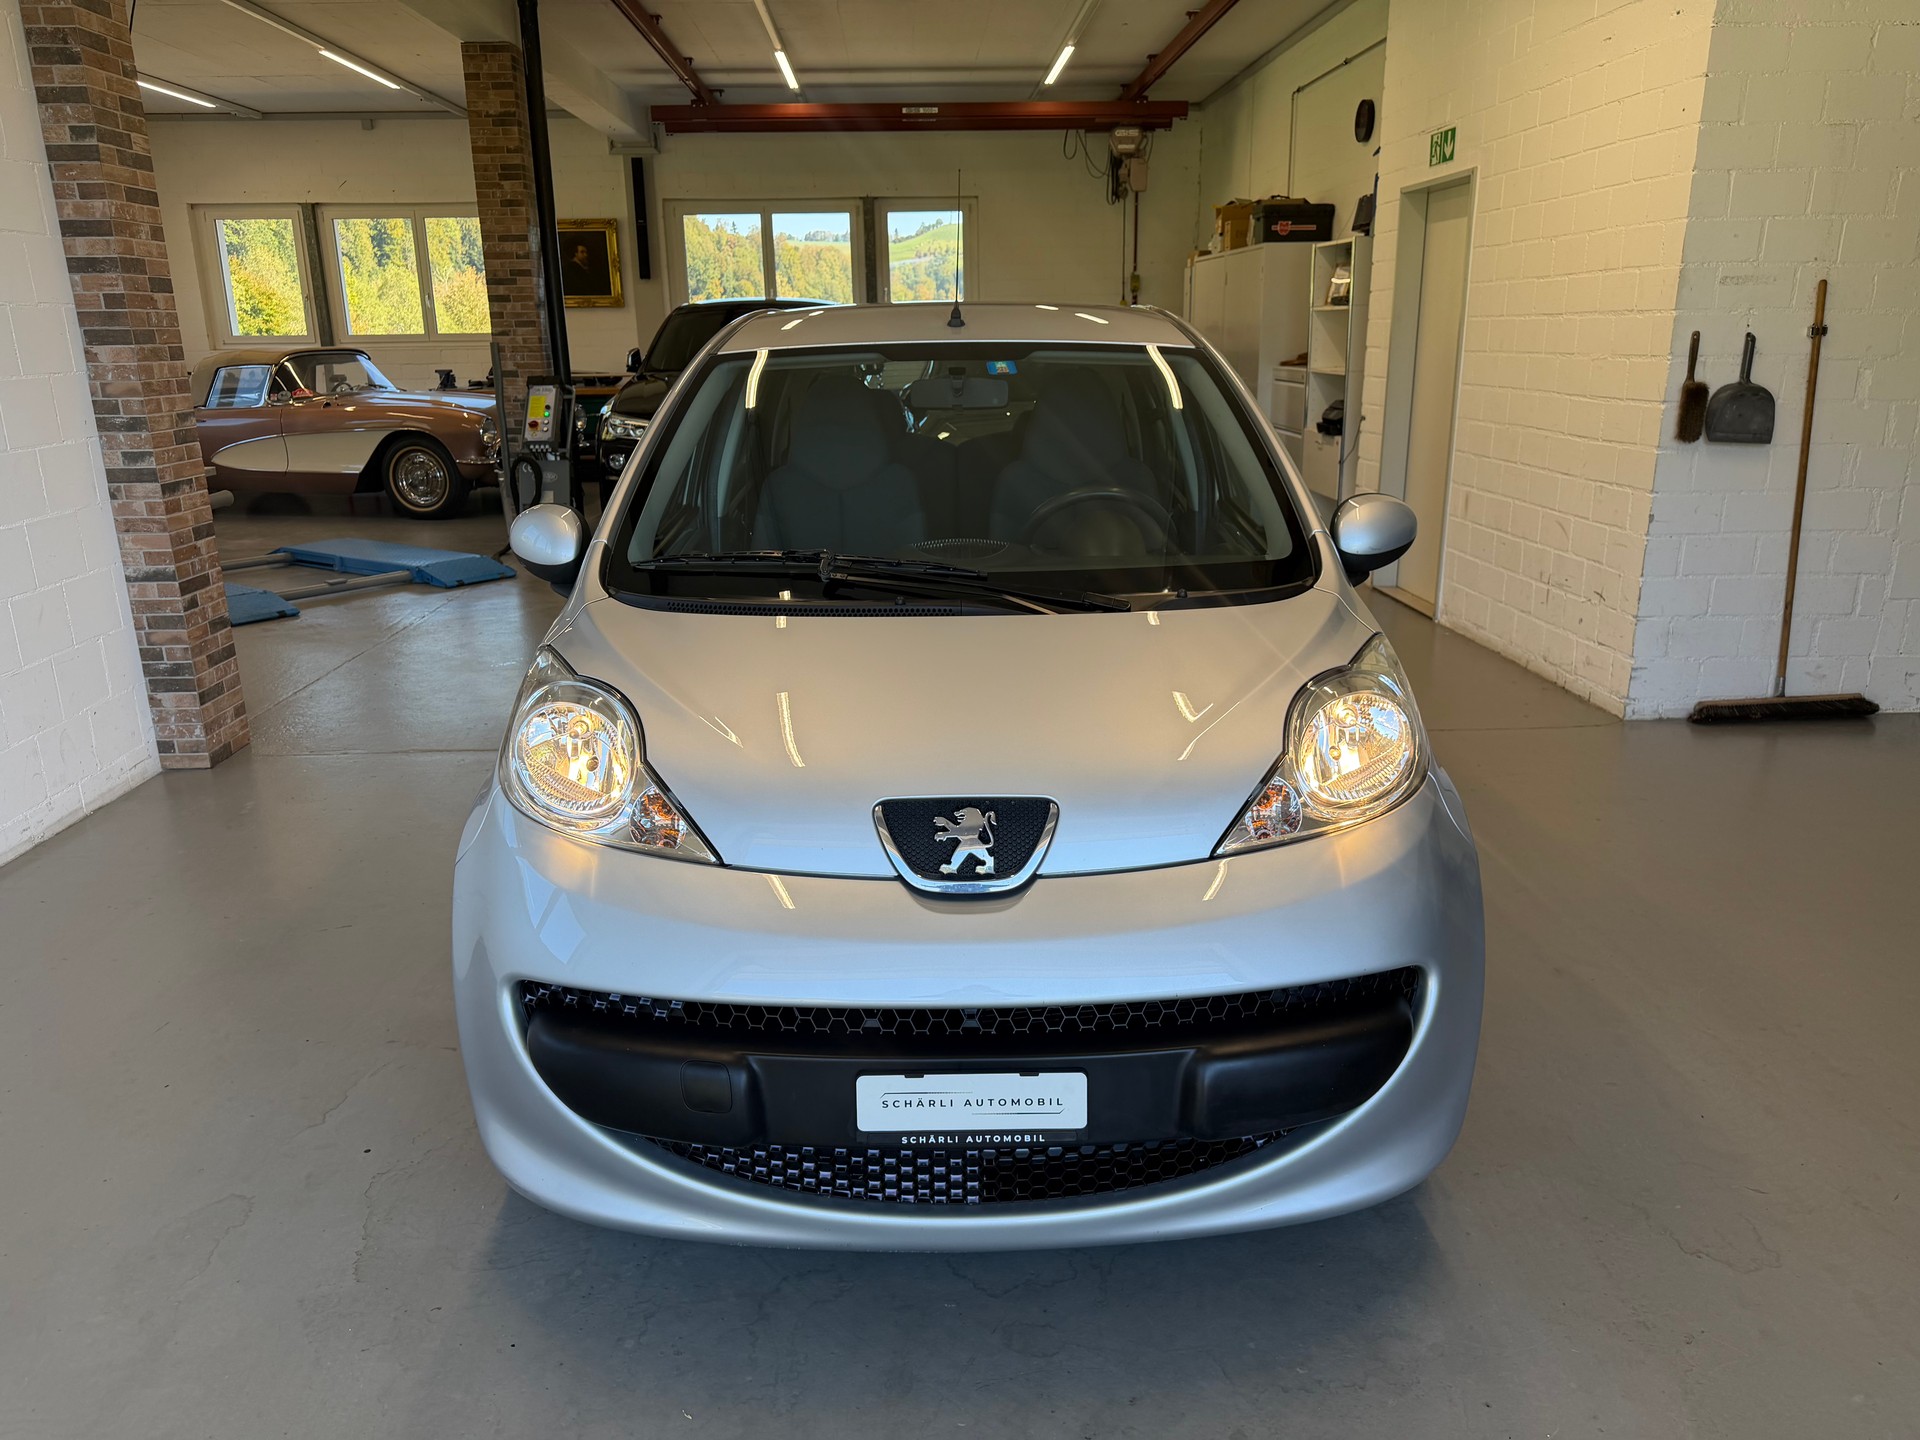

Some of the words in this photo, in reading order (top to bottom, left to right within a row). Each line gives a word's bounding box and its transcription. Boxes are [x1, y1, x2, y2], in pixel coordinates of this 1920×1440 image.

[882, 1098, 954, 1109] SCHÄRLI
[964, 1097, 1064, 1107] AUTOMOBIL
[901, 1134, 959, 1144] SCHÄRLI
[966, 1134, 1046, 1143] AUTOMOBIL
